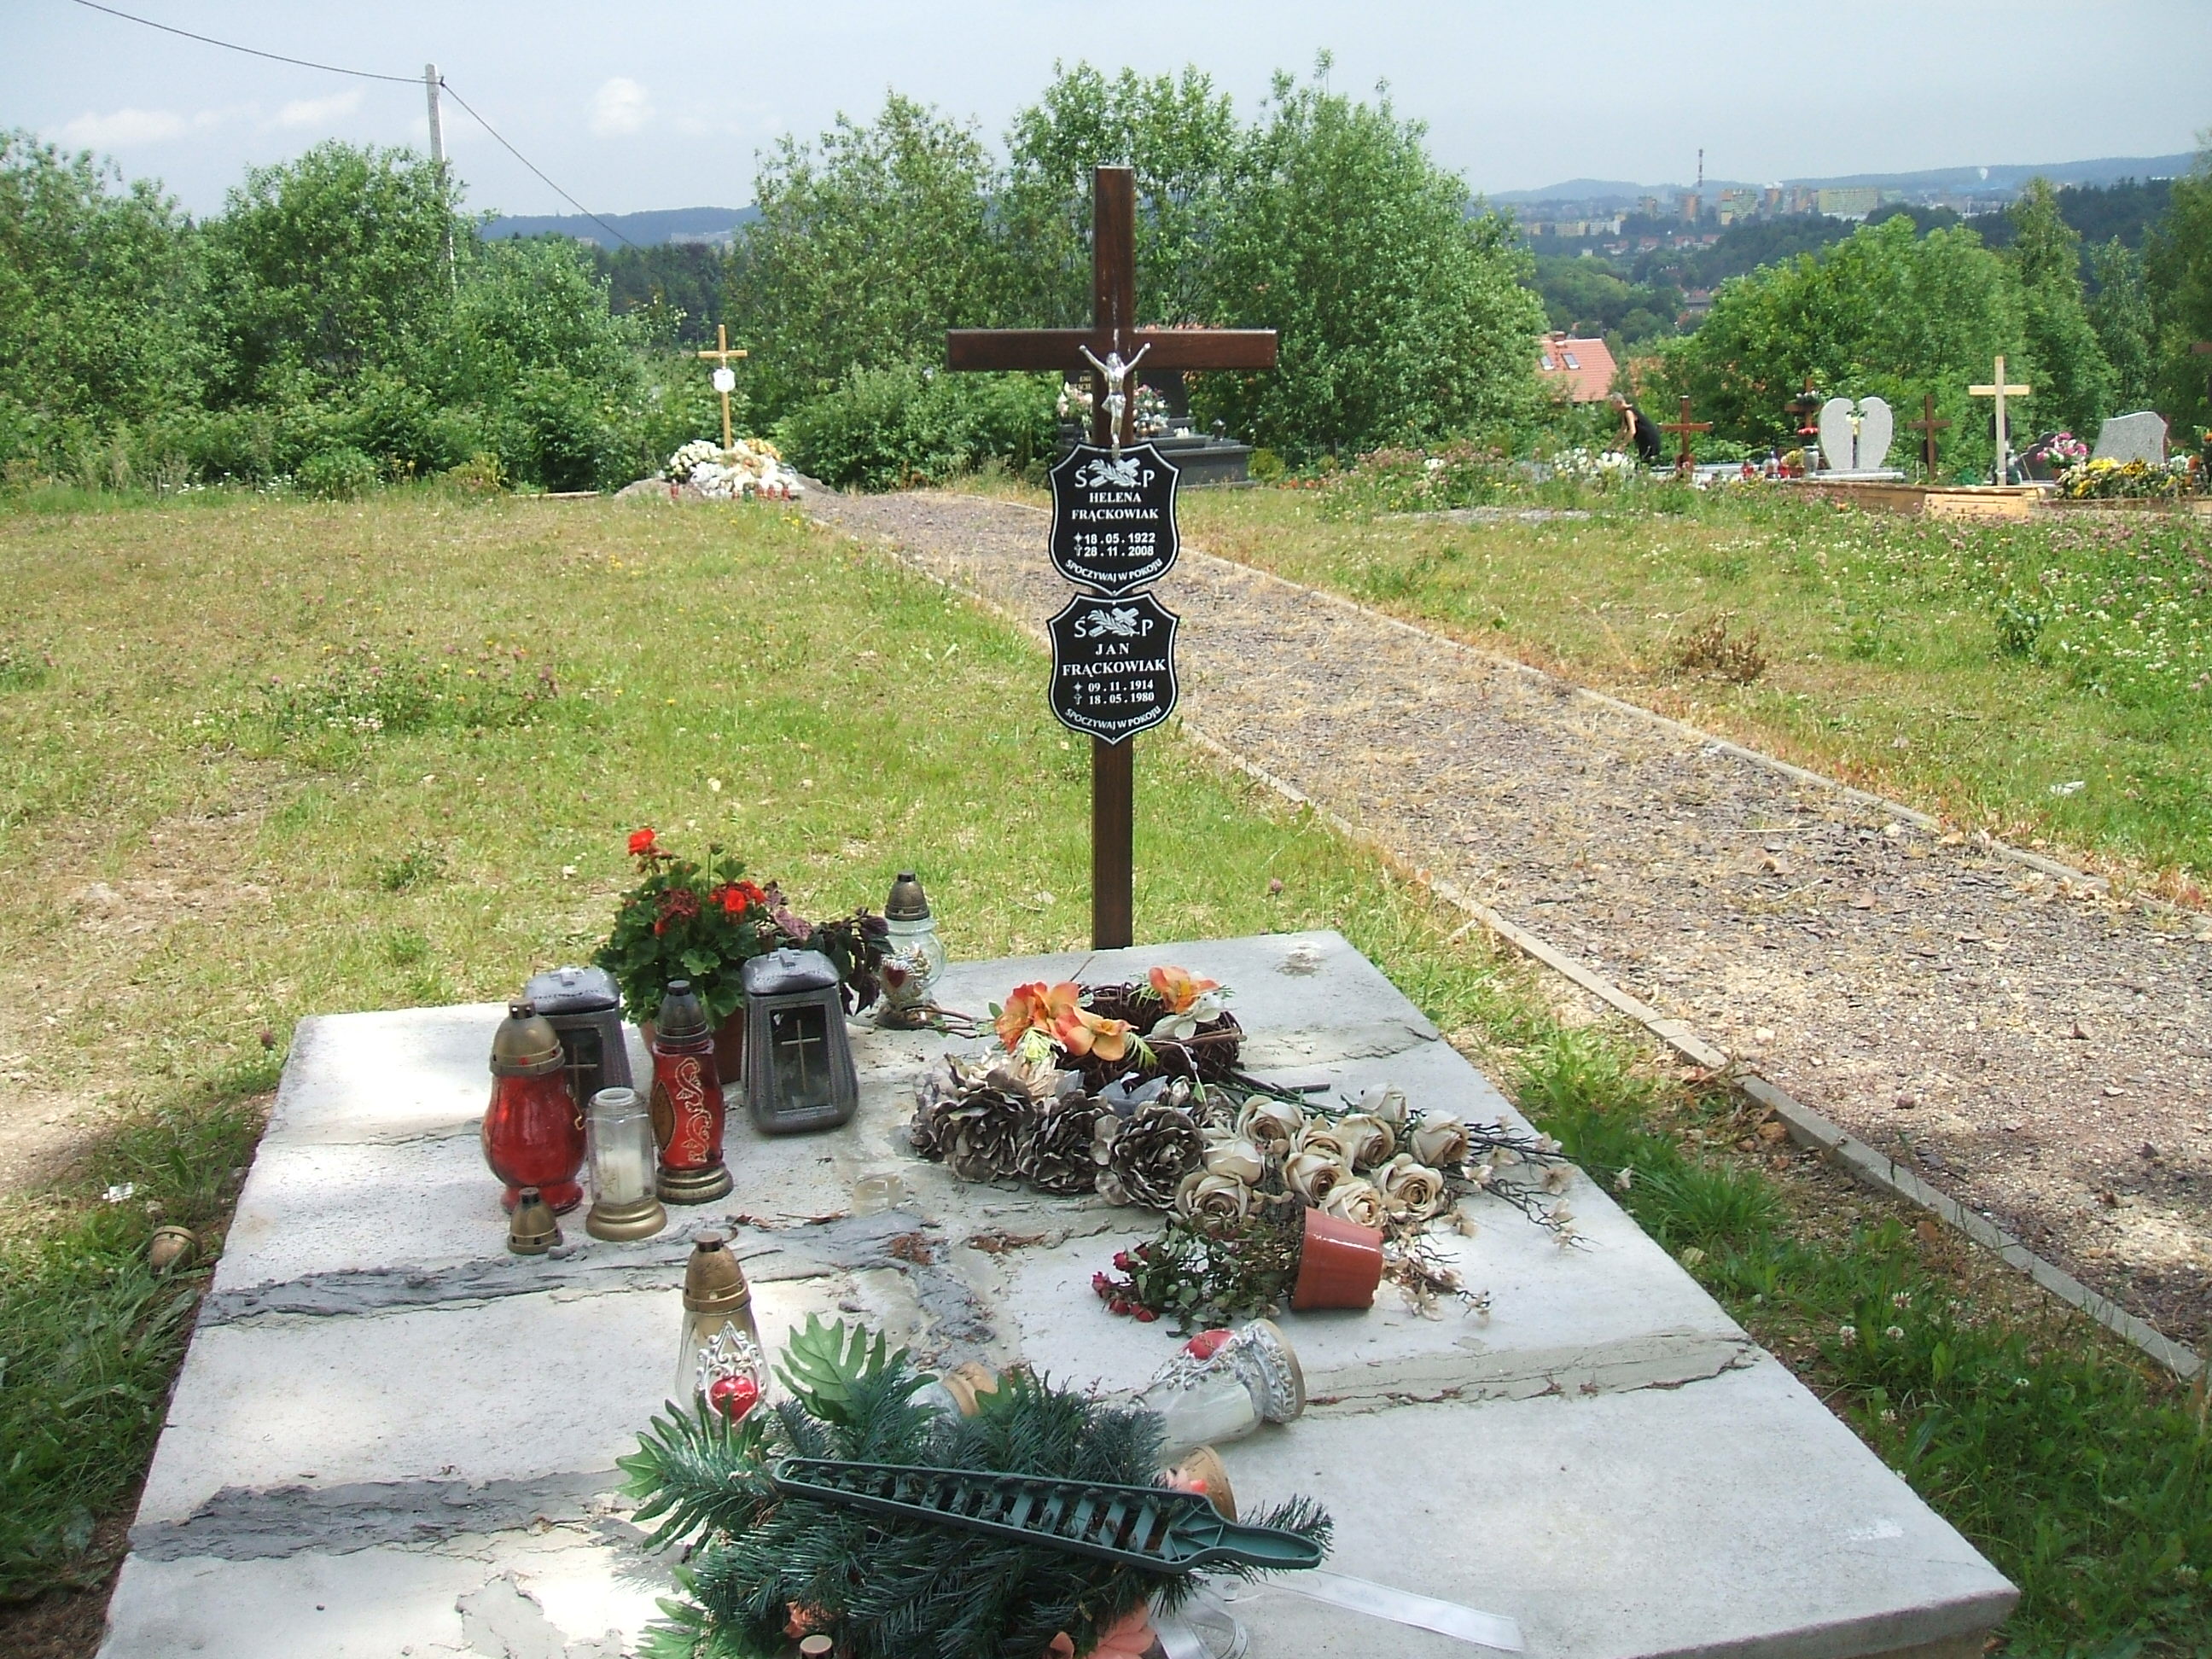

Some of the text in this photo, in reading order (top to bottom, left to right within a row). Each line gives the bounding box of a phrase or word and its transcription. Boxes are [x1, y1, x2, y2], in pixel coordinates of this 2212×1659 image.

[1074, 465, 1155, 488] Ś P
[1089, 492, 1142, 504] HELENA
[1072, 509, 1159, 522] FRĄCKOWIAK
[1065, 557, 1163, 583] SPOCZYWAJ W POKOJU
[1074, 615, 1153, 638] Ś P
[1095, 643, 1130, 655] JAN
[1062, 658, 1166, 678] FRĄCKOWIAK
[1065, 705, 1162, 731] SPOCZYWAJ W POKOJU
